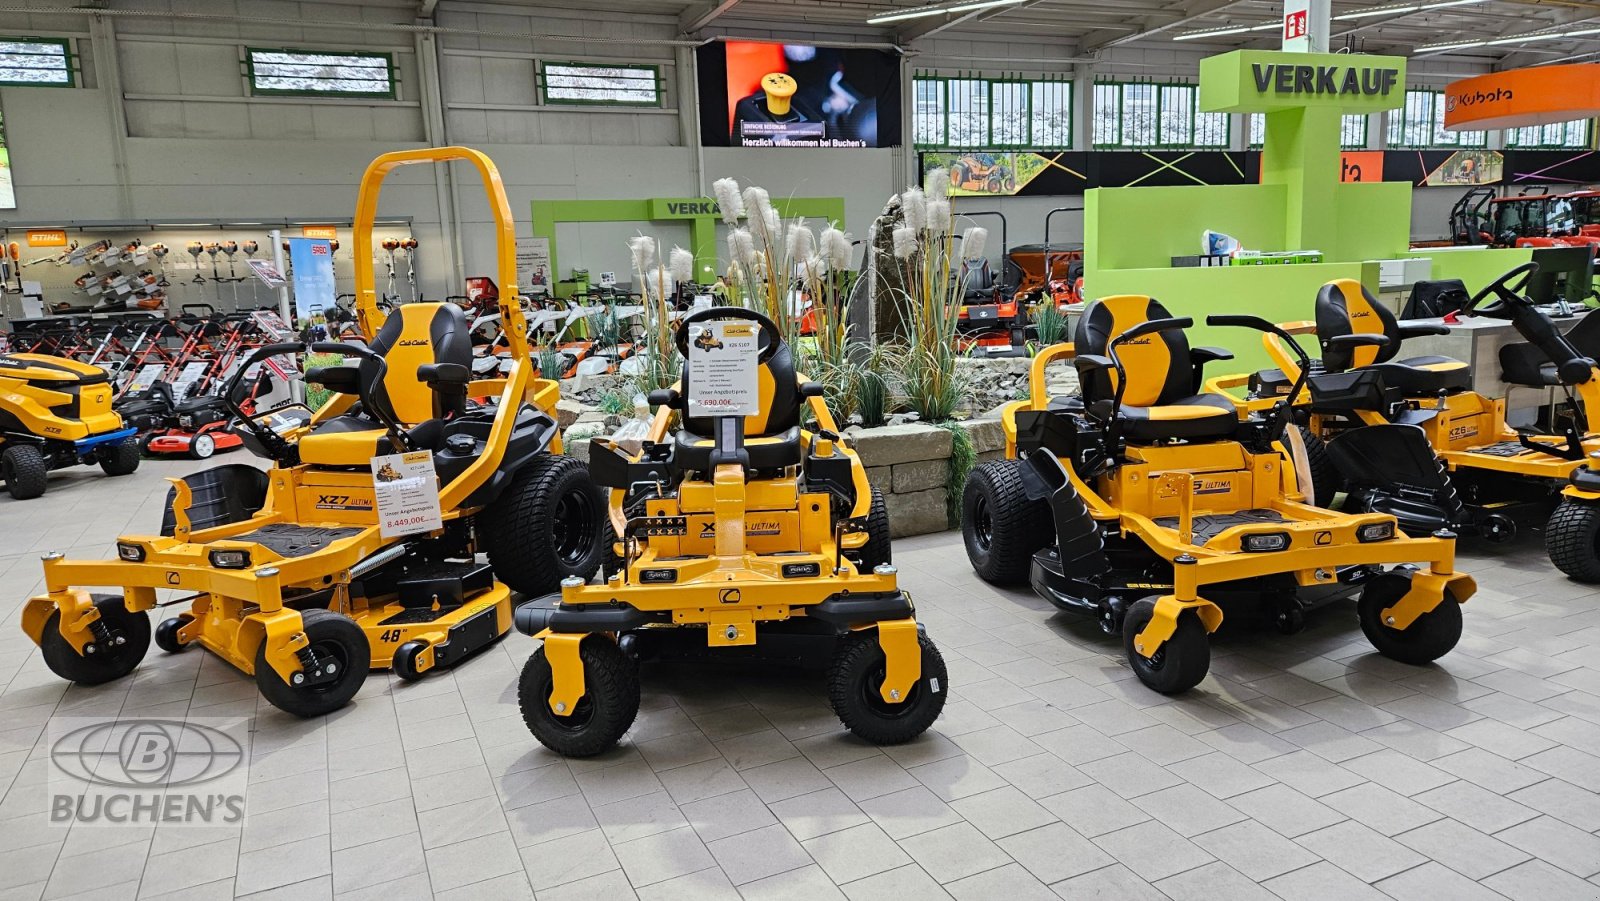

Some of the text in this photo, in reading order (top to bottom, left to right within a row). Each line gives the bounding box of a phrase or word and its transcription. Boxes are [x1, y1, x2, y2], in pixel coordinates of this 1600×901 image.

[1252, 62, 1399, 96] VERKAUF
[1459, 88, 1513, 106] Kubota
[742, 138, 773, 147] Herzlich
[775, 138, 818, 147] willkommen
[820, 138, 831, 147] bei
[667, 202, 721, 215] VERKA
[31, 234, 62, 242] STIHL
[306, 229, 334, 237] STIHL
[1205, 481, 1231, 489] ULTIMA
[317, 494, 350, 505] XZ7
[350, 498, 373, 506] ULTIMA
[387, 516, 426, 529] 8.449,00€
[751, 522, 780, 530] ULTIMA
